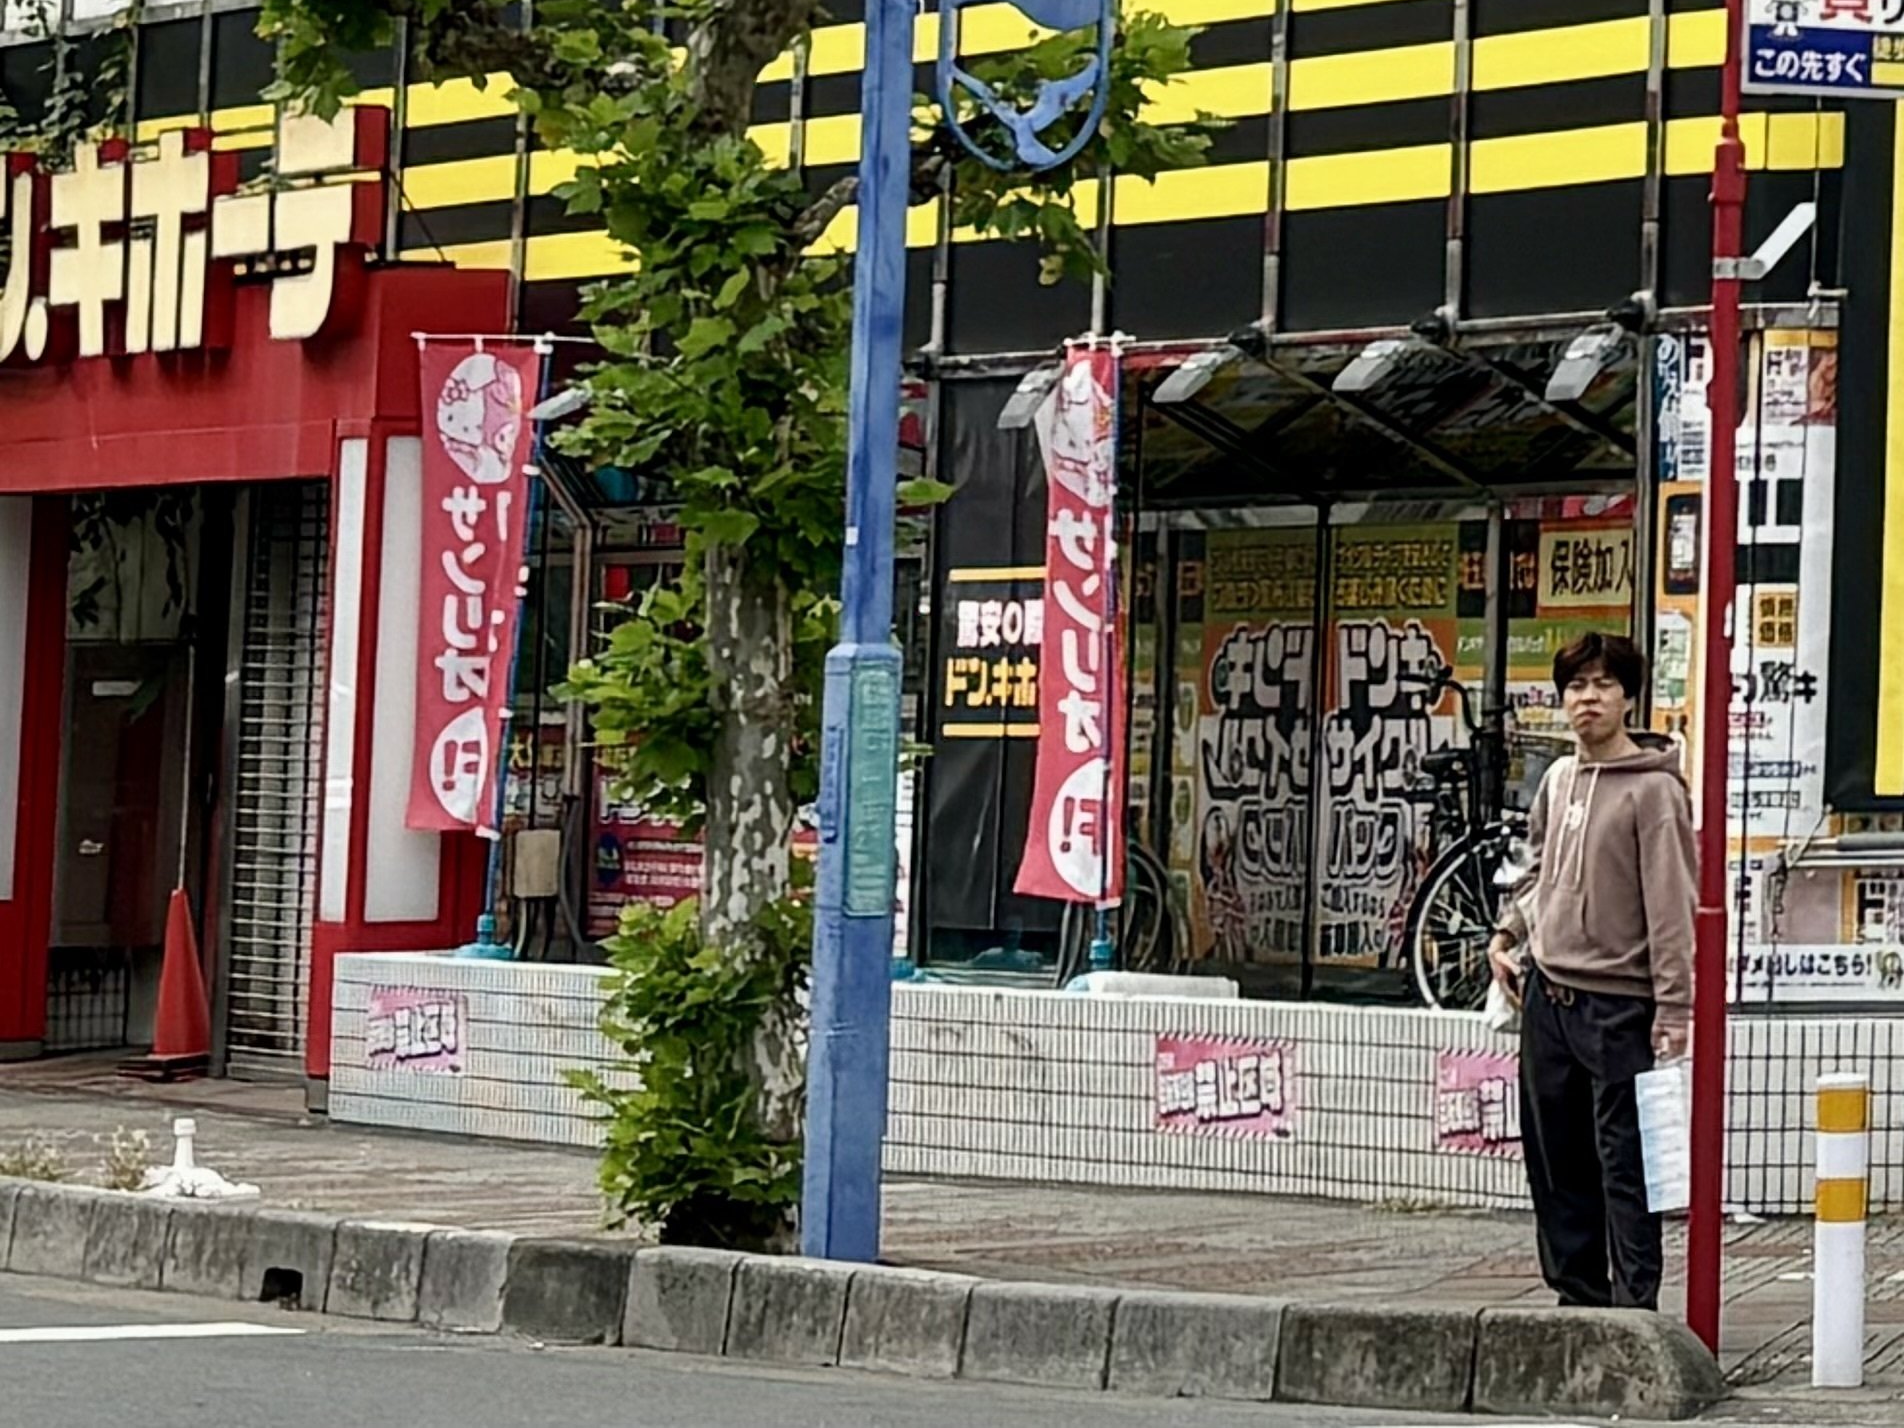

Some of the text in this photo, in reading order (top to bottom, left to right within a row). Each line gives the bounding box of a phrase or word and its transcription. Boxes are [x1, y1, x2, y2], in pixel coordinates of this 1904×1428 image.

[1754, 47, 1868, 83] この先すぐ
